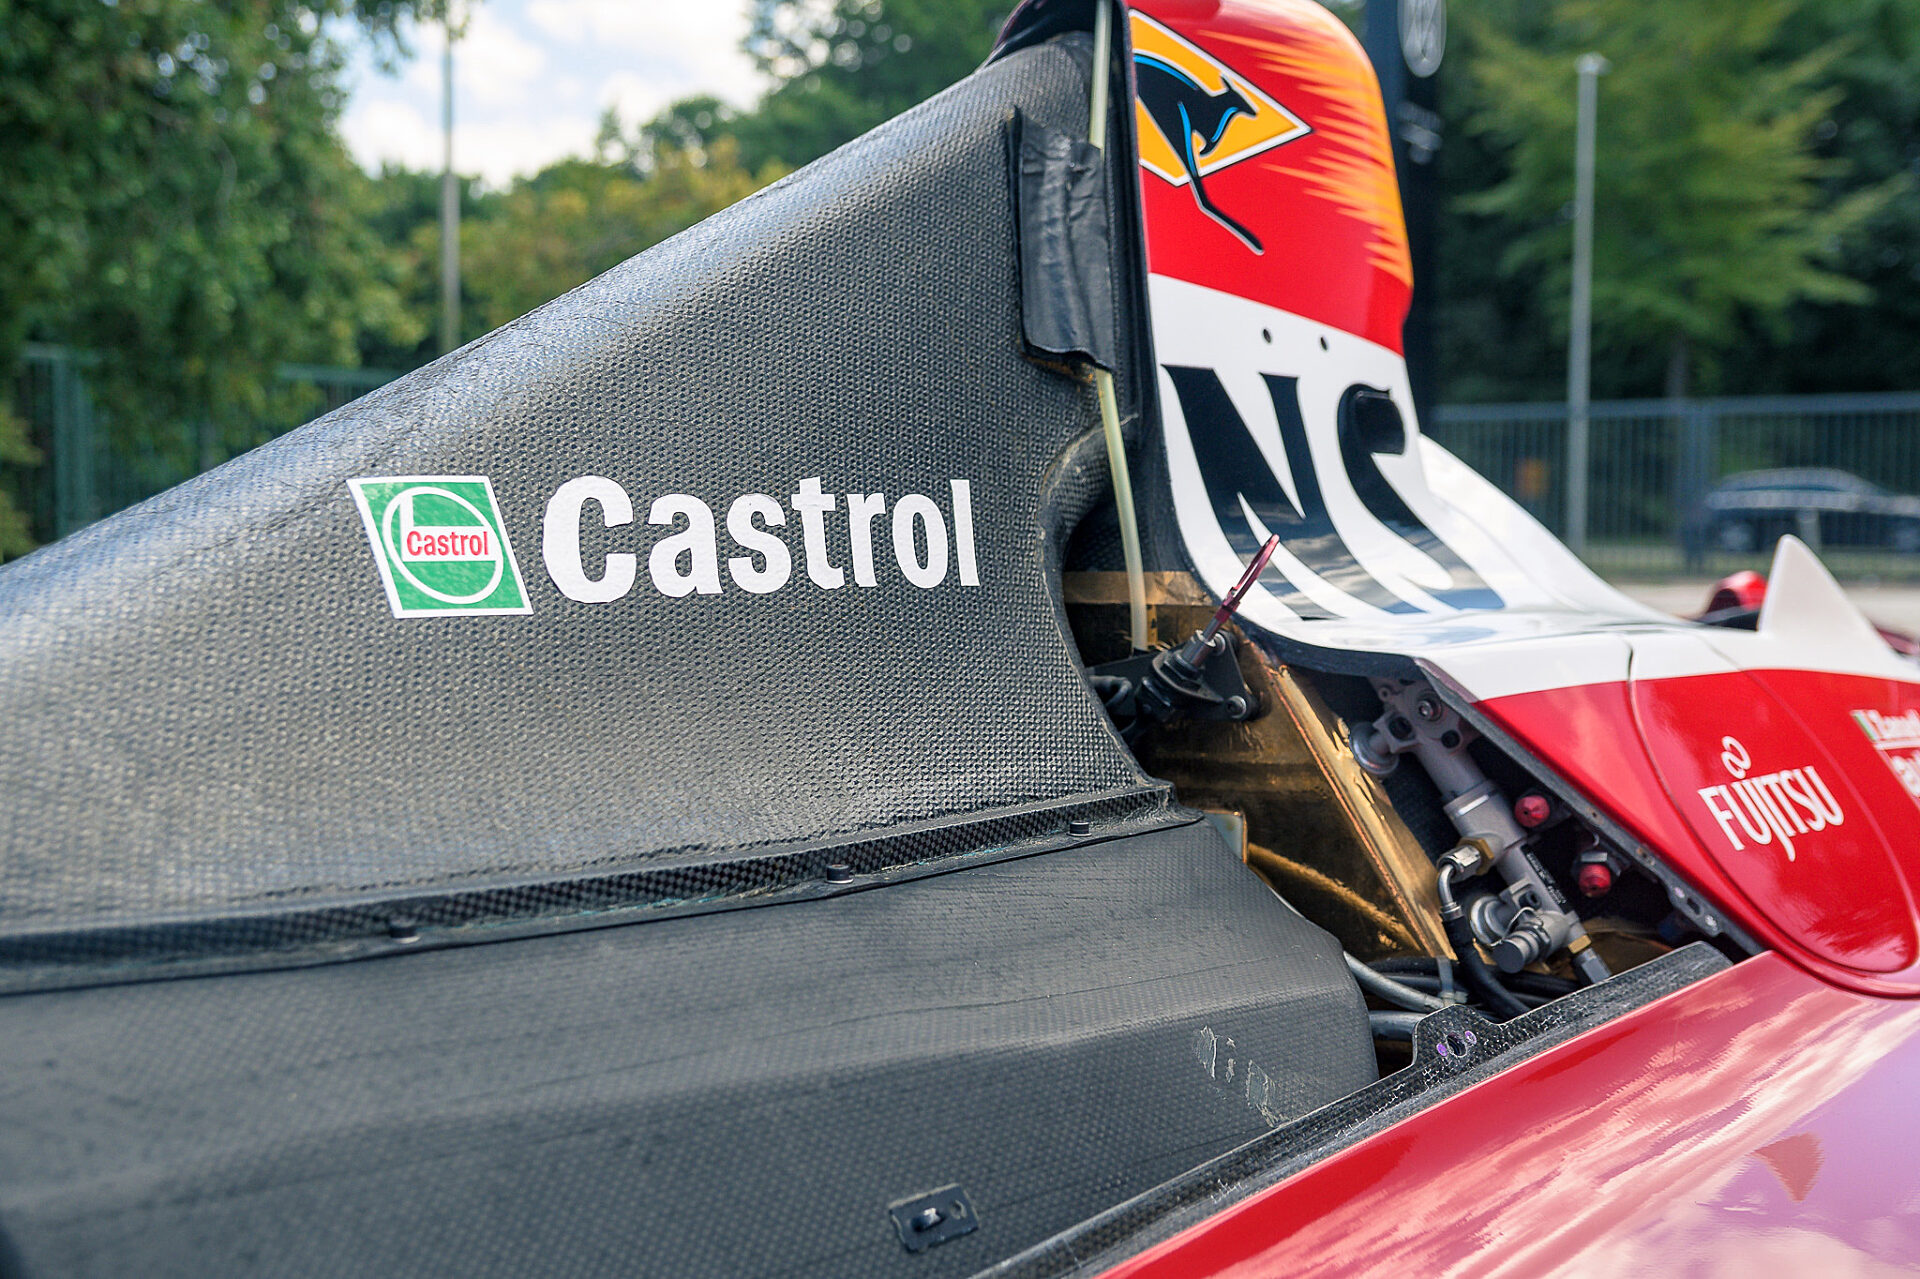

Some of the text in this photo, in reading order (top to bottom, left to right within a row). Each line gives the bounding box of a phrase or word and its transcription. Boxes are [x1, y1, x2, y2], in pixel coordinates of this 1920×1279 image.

[407, 531, 489, 556] Castrol
[542, 475, 980, 603] Castrol
[1698, 765, 1844, 862] FUJITSU
